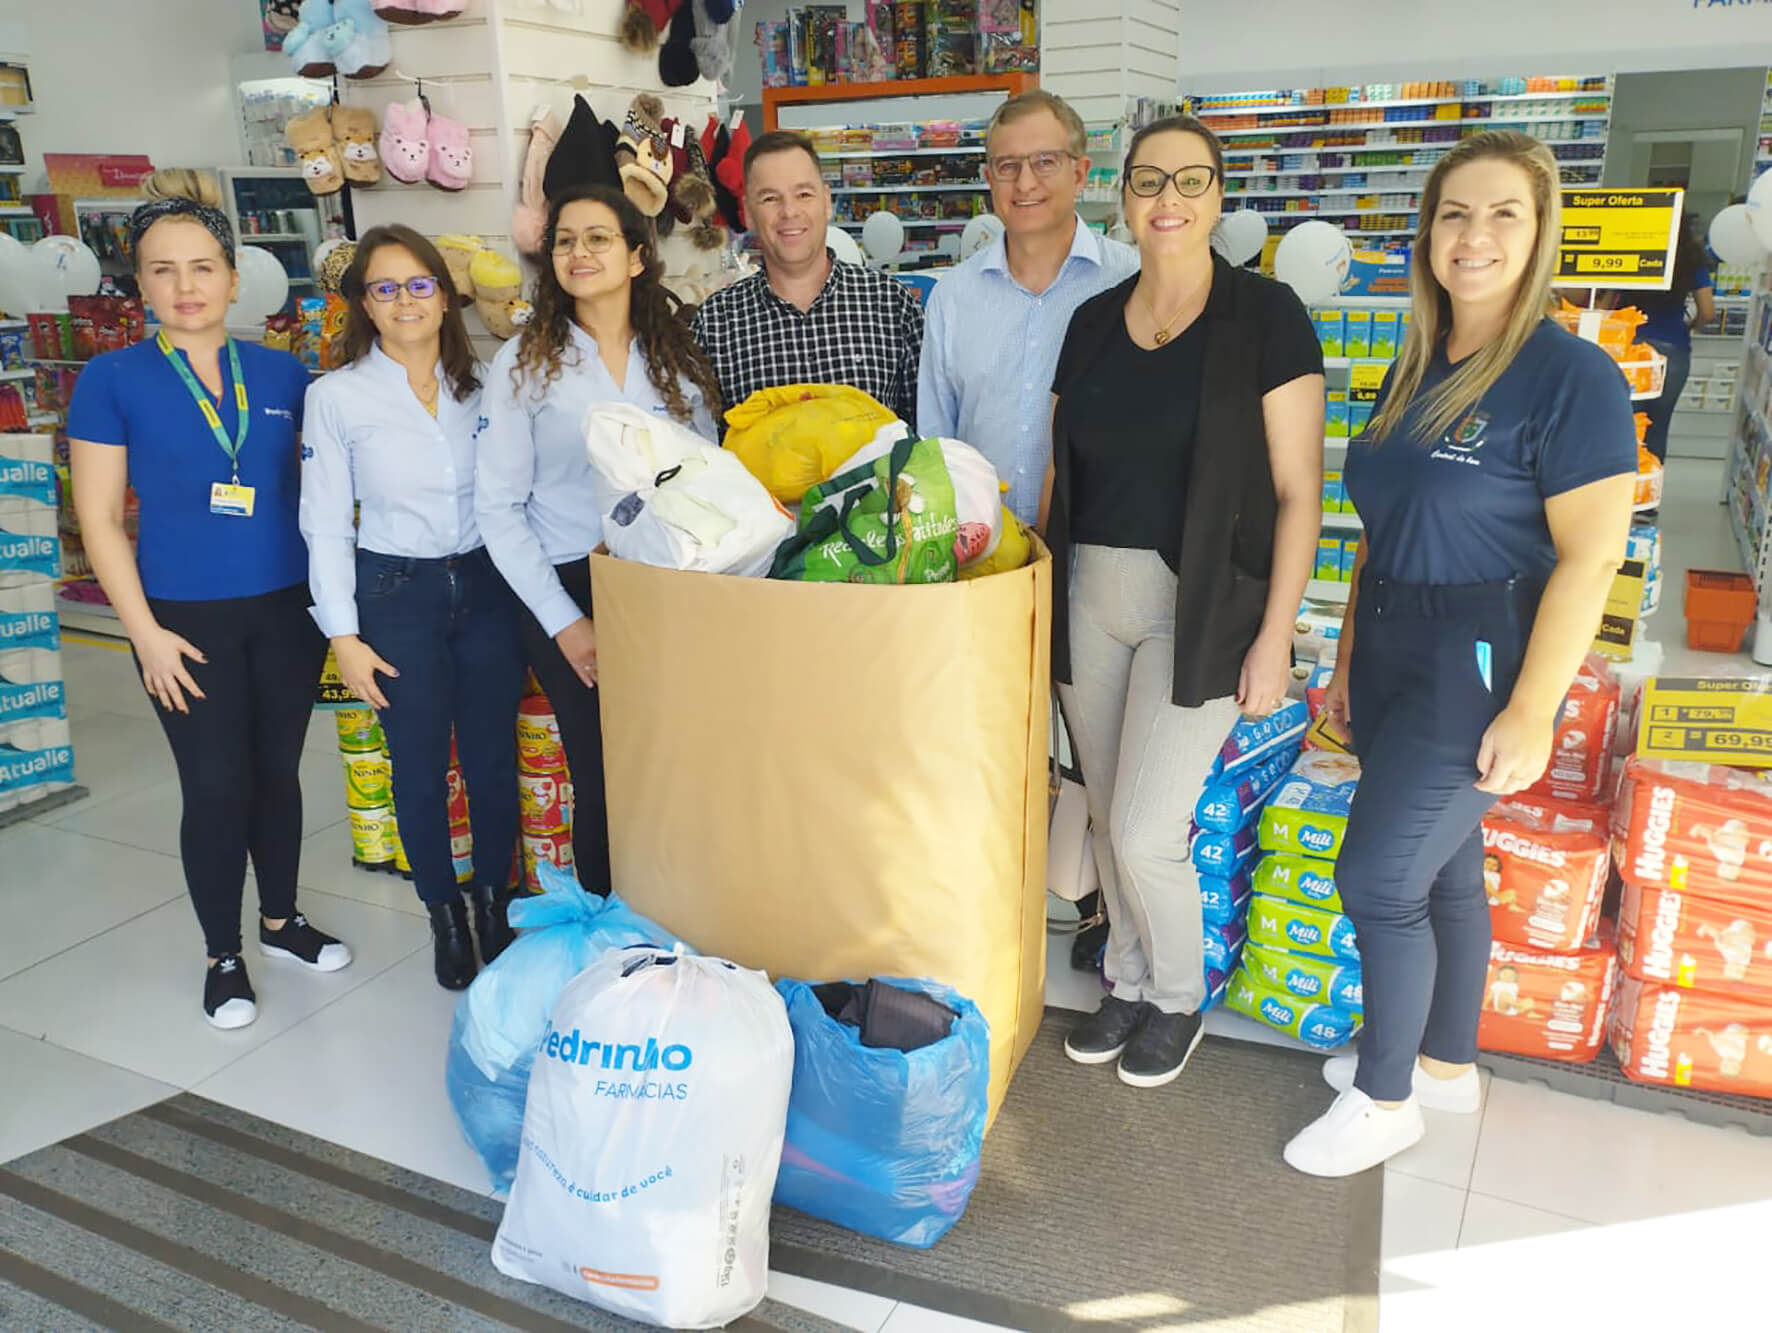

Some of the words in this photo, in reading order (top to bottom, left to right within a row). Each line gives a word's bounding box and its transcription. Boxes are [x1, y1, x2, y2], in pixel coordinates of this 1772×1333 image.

[1572, 195, 1606, 207] Super
[1607, 195, 1644, 206] Oferta
[1592, 257, 1624, 269] 9,99
[0, 539, 53, 558] ualle
[1602, 623, 1626, 635] Cada
[1696, 680, 1739, 691] Super
[1203, 803, 1228, 816] 42
[1273, 822, 1289, 840] M
[1634, 785, 1676, 881] HUGGIES
[1200, 844, 1223, 859] 42
[1481, 825, 1568, 868] UGGIES
[1272, 865, 1290, 883] M
[1261, 915, 1277, 931] M
[1641, 889, 1682, 979] HUGGIES
[1639, 991, 1681, 1078] HUGGIES
[576, 1187, 618, 1202] cuidar
[621, 1182, 638, 1198] de
